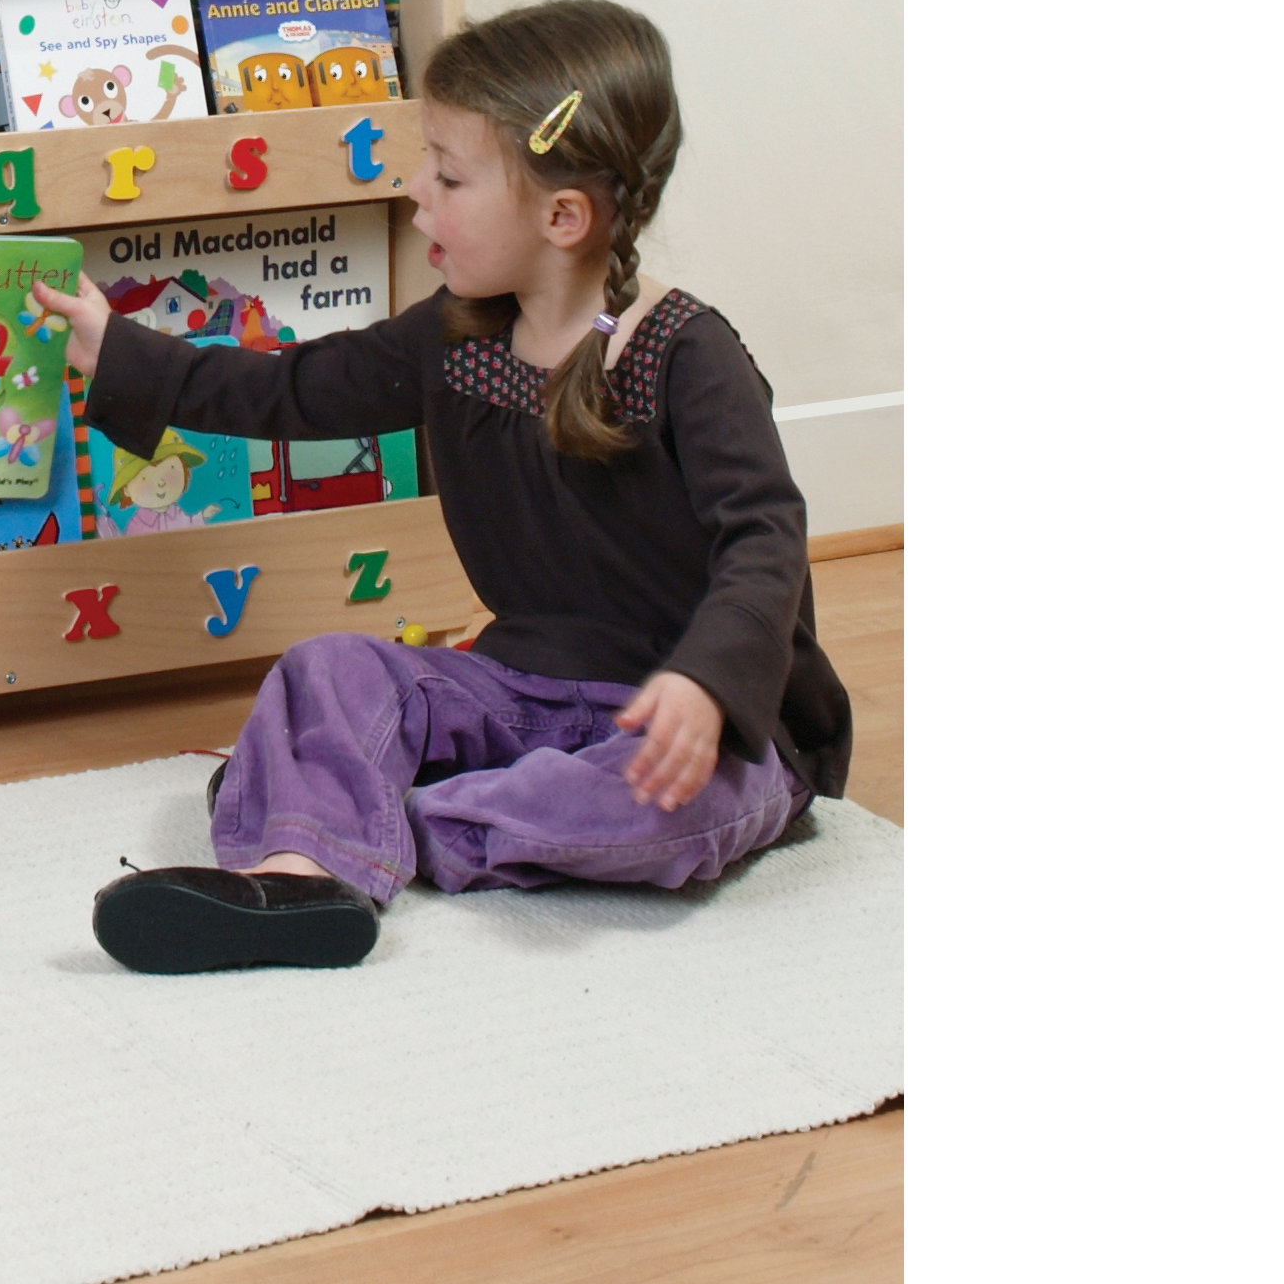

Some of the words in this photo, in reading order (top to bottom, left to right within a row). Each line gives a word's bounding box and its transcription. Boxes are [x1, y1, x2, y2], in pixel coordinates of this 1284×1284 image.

[207, 0, 261, 19] Annie
[39, 40, 63, 52] See
[67, 37, 91, 50] and
[95, 36, 118, 50] Spy
[122, 32, 168, 47] Shapes
[104, 145, 156, 201] r
[226, 136, 269, 191] s
[341, 117, 385, 182] t
[109, 232, 161, 264] Old
[173, 214, 336, 258] Macdonald
[262, 250, 317, 282] had
[330, 253, 348, 275] a
[300, 283, 372, 311] farm
[62, 584, 121, 643] x
[203, 565, 260, 638] y
[345, 549, 391, 603] z
